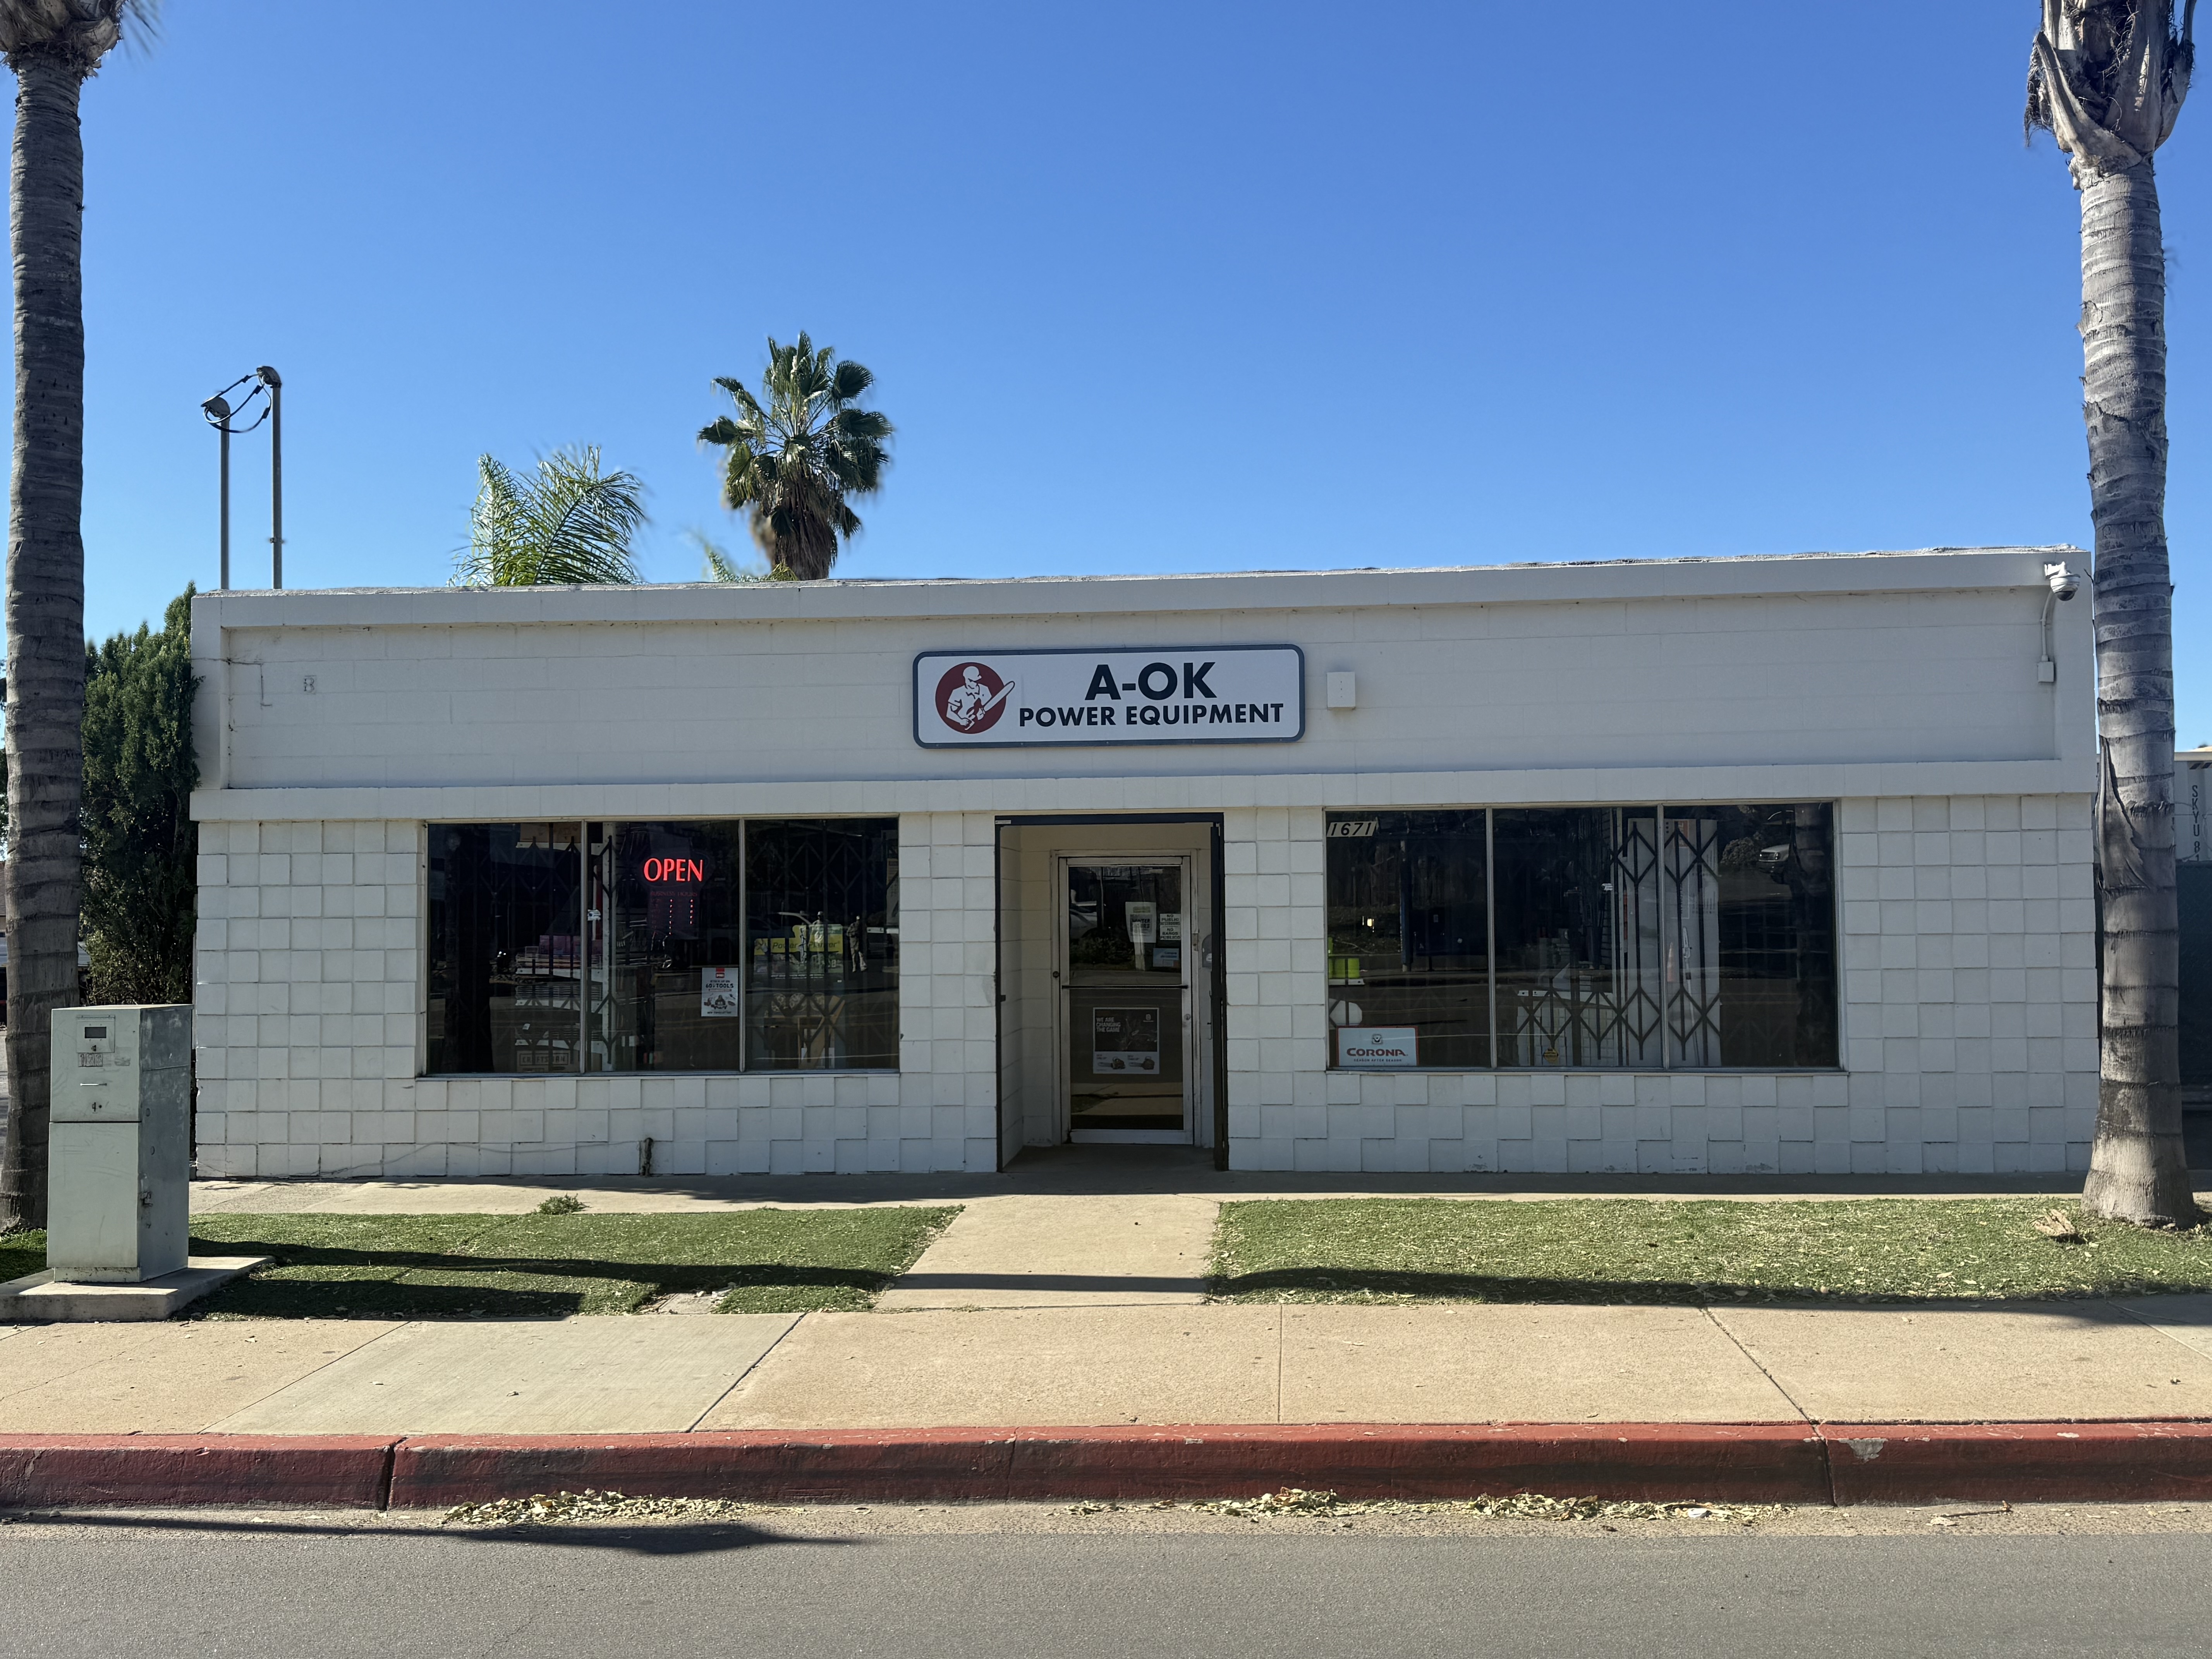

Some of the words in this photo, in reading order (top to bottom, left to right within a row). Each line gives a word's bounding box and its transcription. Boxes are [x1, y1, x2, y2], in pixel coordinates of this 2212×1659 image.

[1084, 661, 1217, 701] A-OK
[1019, 706, 1116, 727] POWER
[1126, 702, 1284, 726] EQUIPMENT
[1331, 822, 1372, 836] 1671
[643, 858, 703, 882] OPEN
[1346, 1048, 1407, 1056] CORONA
